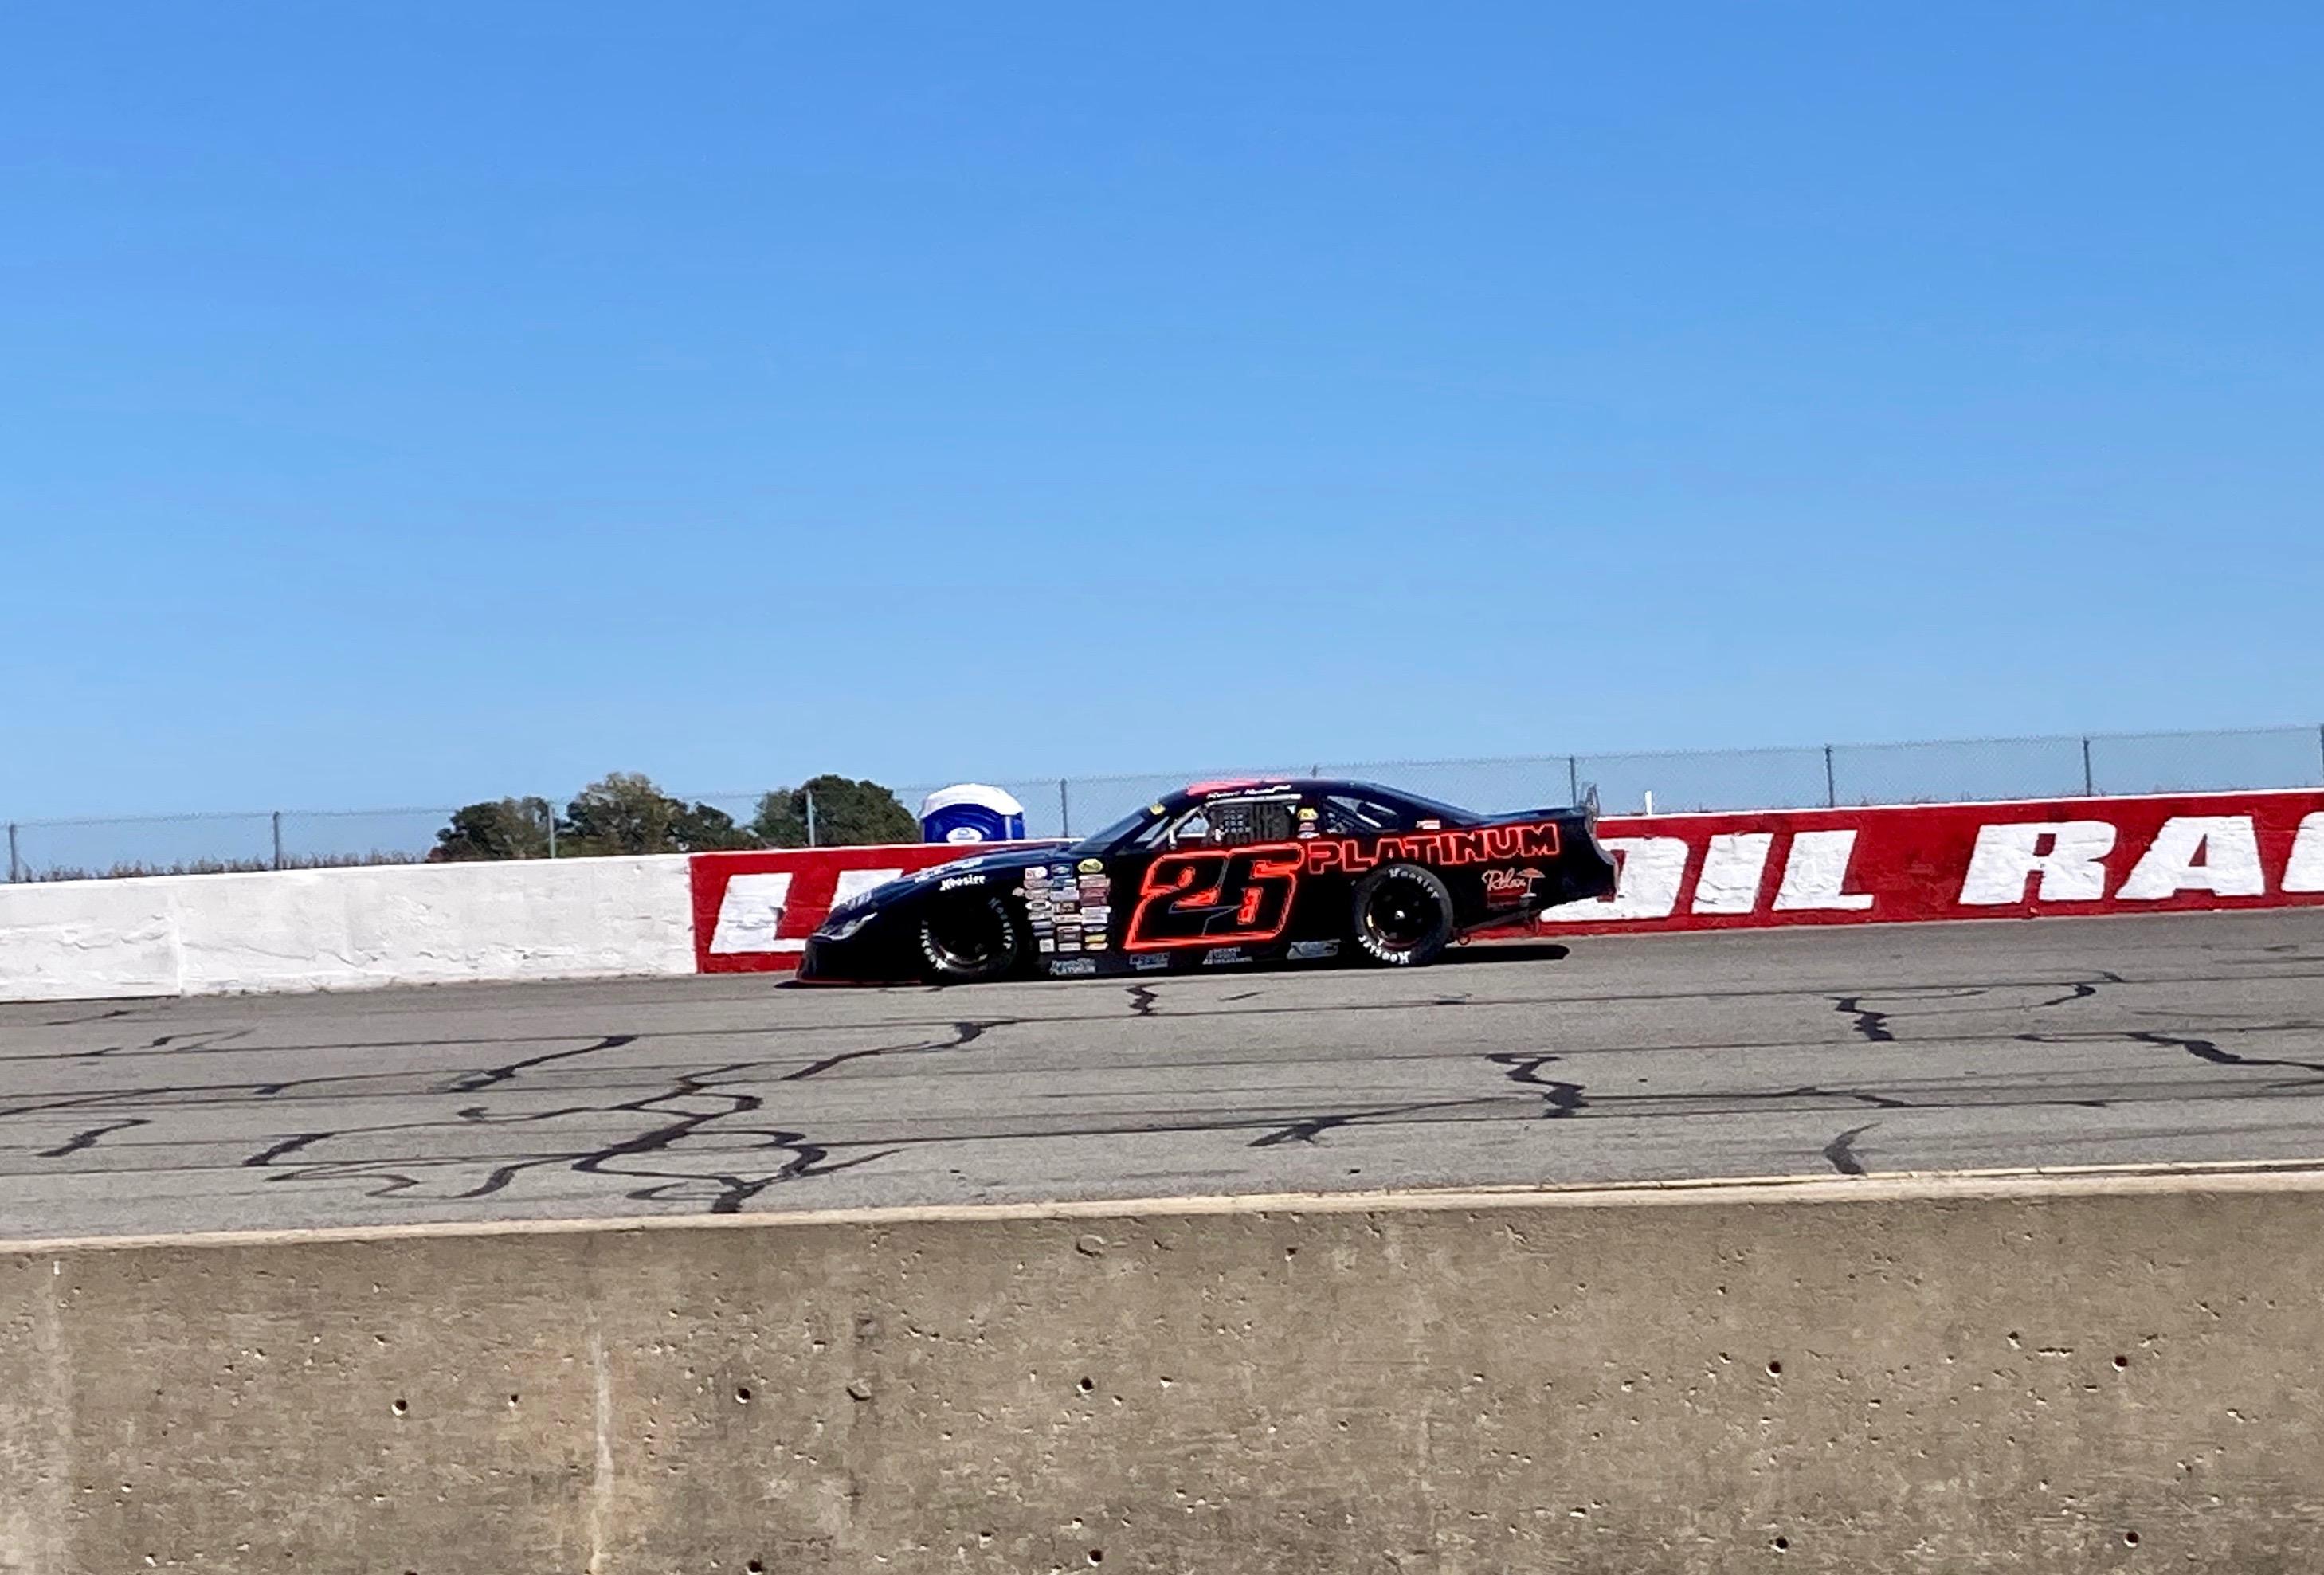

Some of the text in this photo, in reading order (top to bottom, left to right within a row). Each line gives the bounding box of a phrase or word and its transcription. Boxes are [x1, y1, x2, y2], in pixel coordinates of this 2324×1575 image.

[1308, 823, 1559, 874] PLATINUM
[1958, 812, 2324, 905] RA
[939, 874, 986, 891] Hoosier
[1389, 868, 1440, 899] Hoosier
[1481, 867, 1526, 891] Relax
